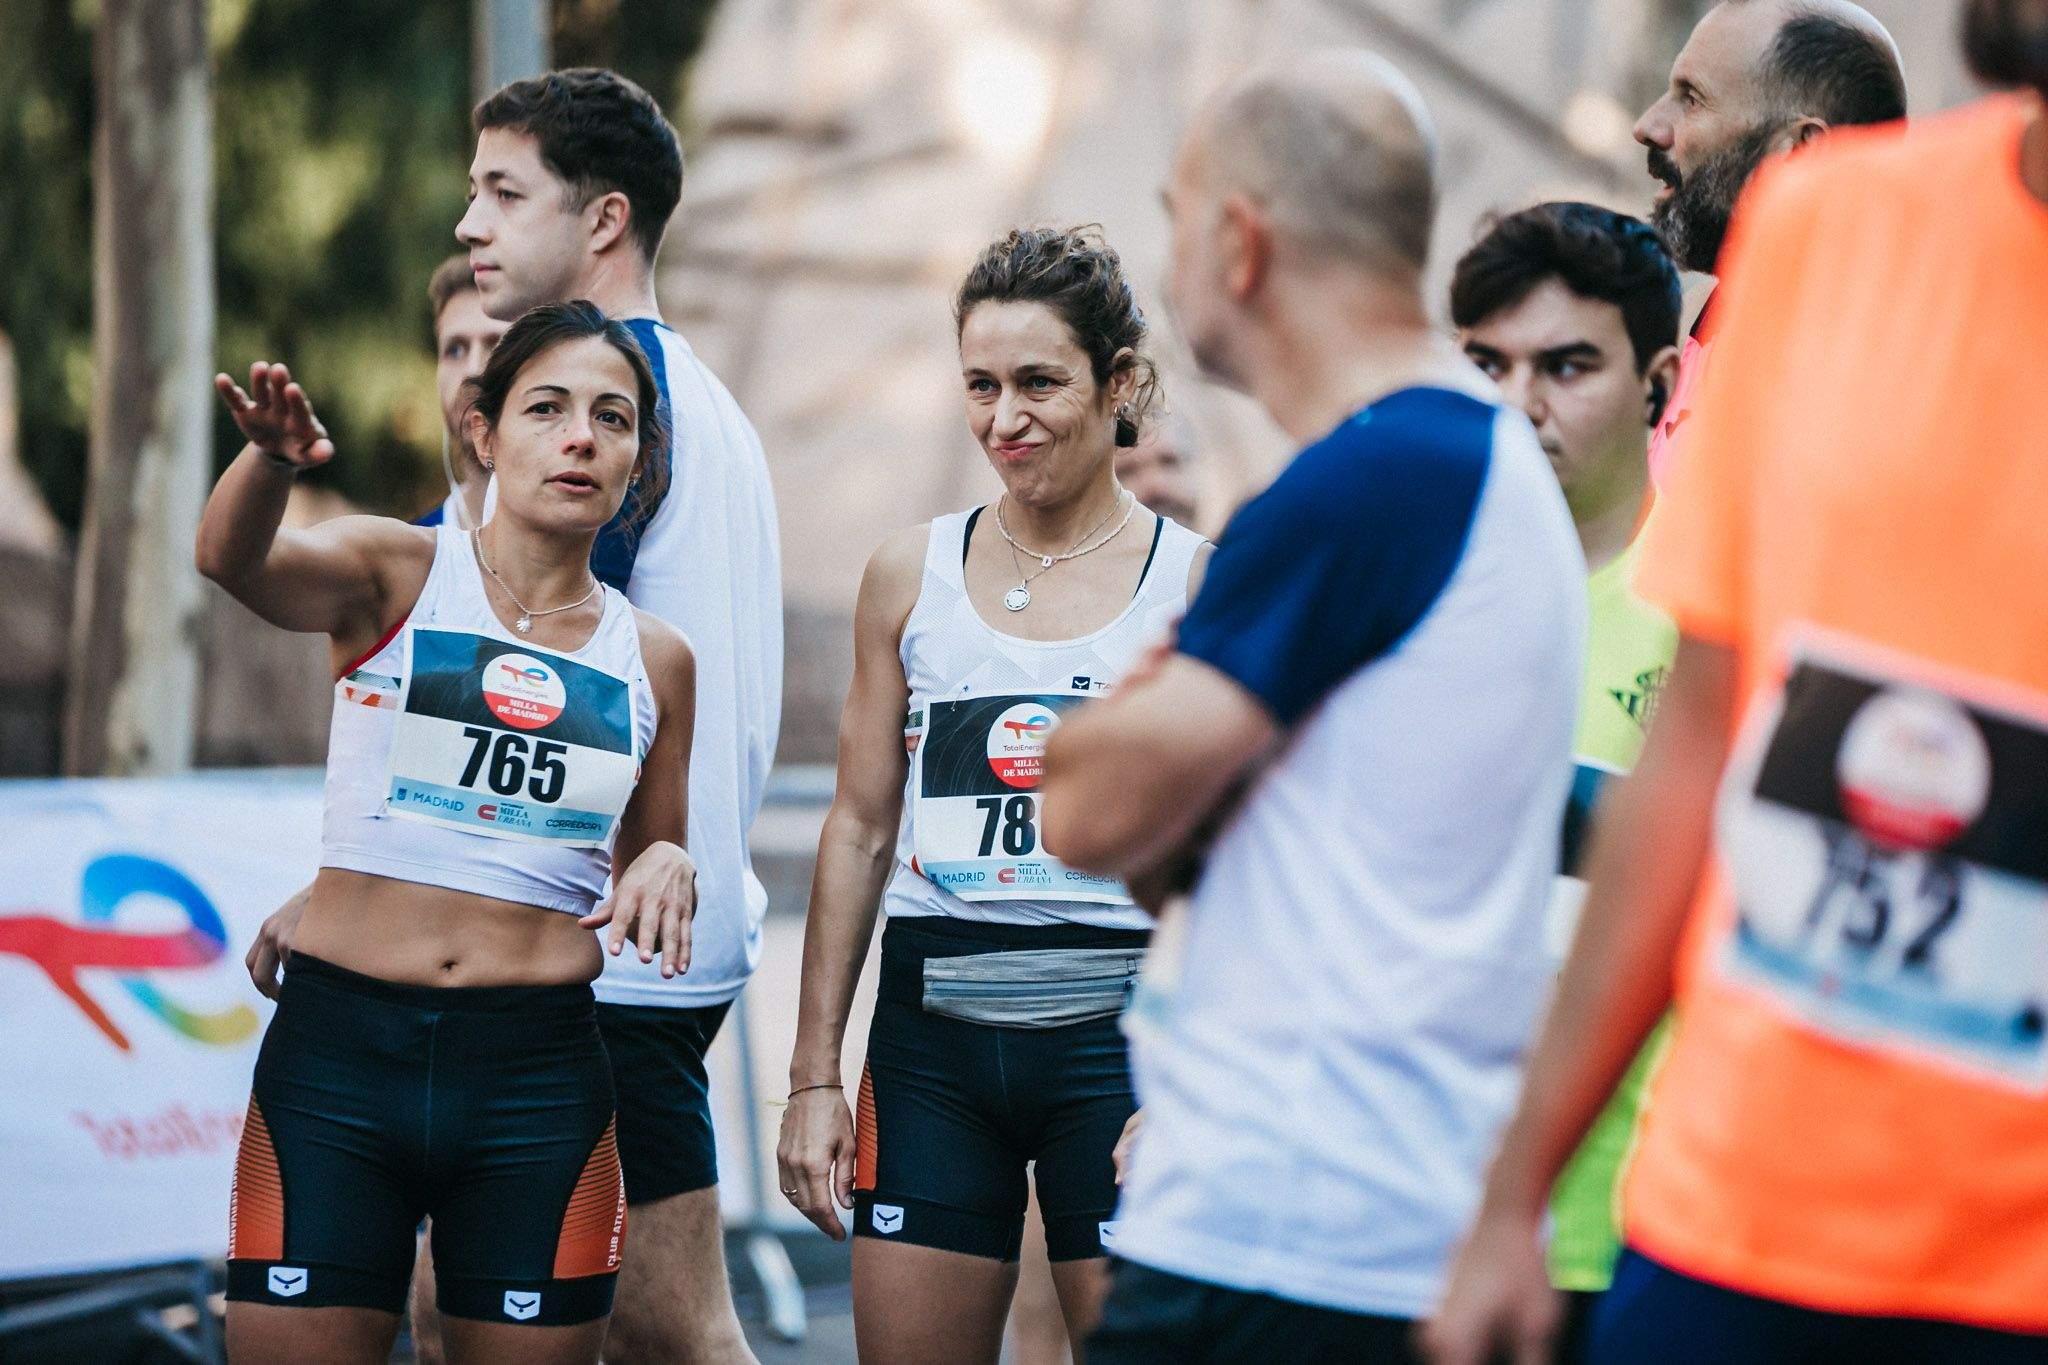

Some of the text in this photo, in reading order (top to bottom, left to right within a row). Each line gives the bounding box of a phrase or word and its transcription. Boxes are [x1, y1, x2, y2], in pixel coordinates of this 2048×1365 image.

[458, 726, 568, 804] 765
[1003, 769, 1015, 777] DE
[1013, 759, 1039, 768] MILLA
[413, 792, 464, 812] MADRID
[976, 795, 1046, 857] 78
[943, 872, 986, 884] MADRID
[607, 1236, 619, 1267] CLUB
